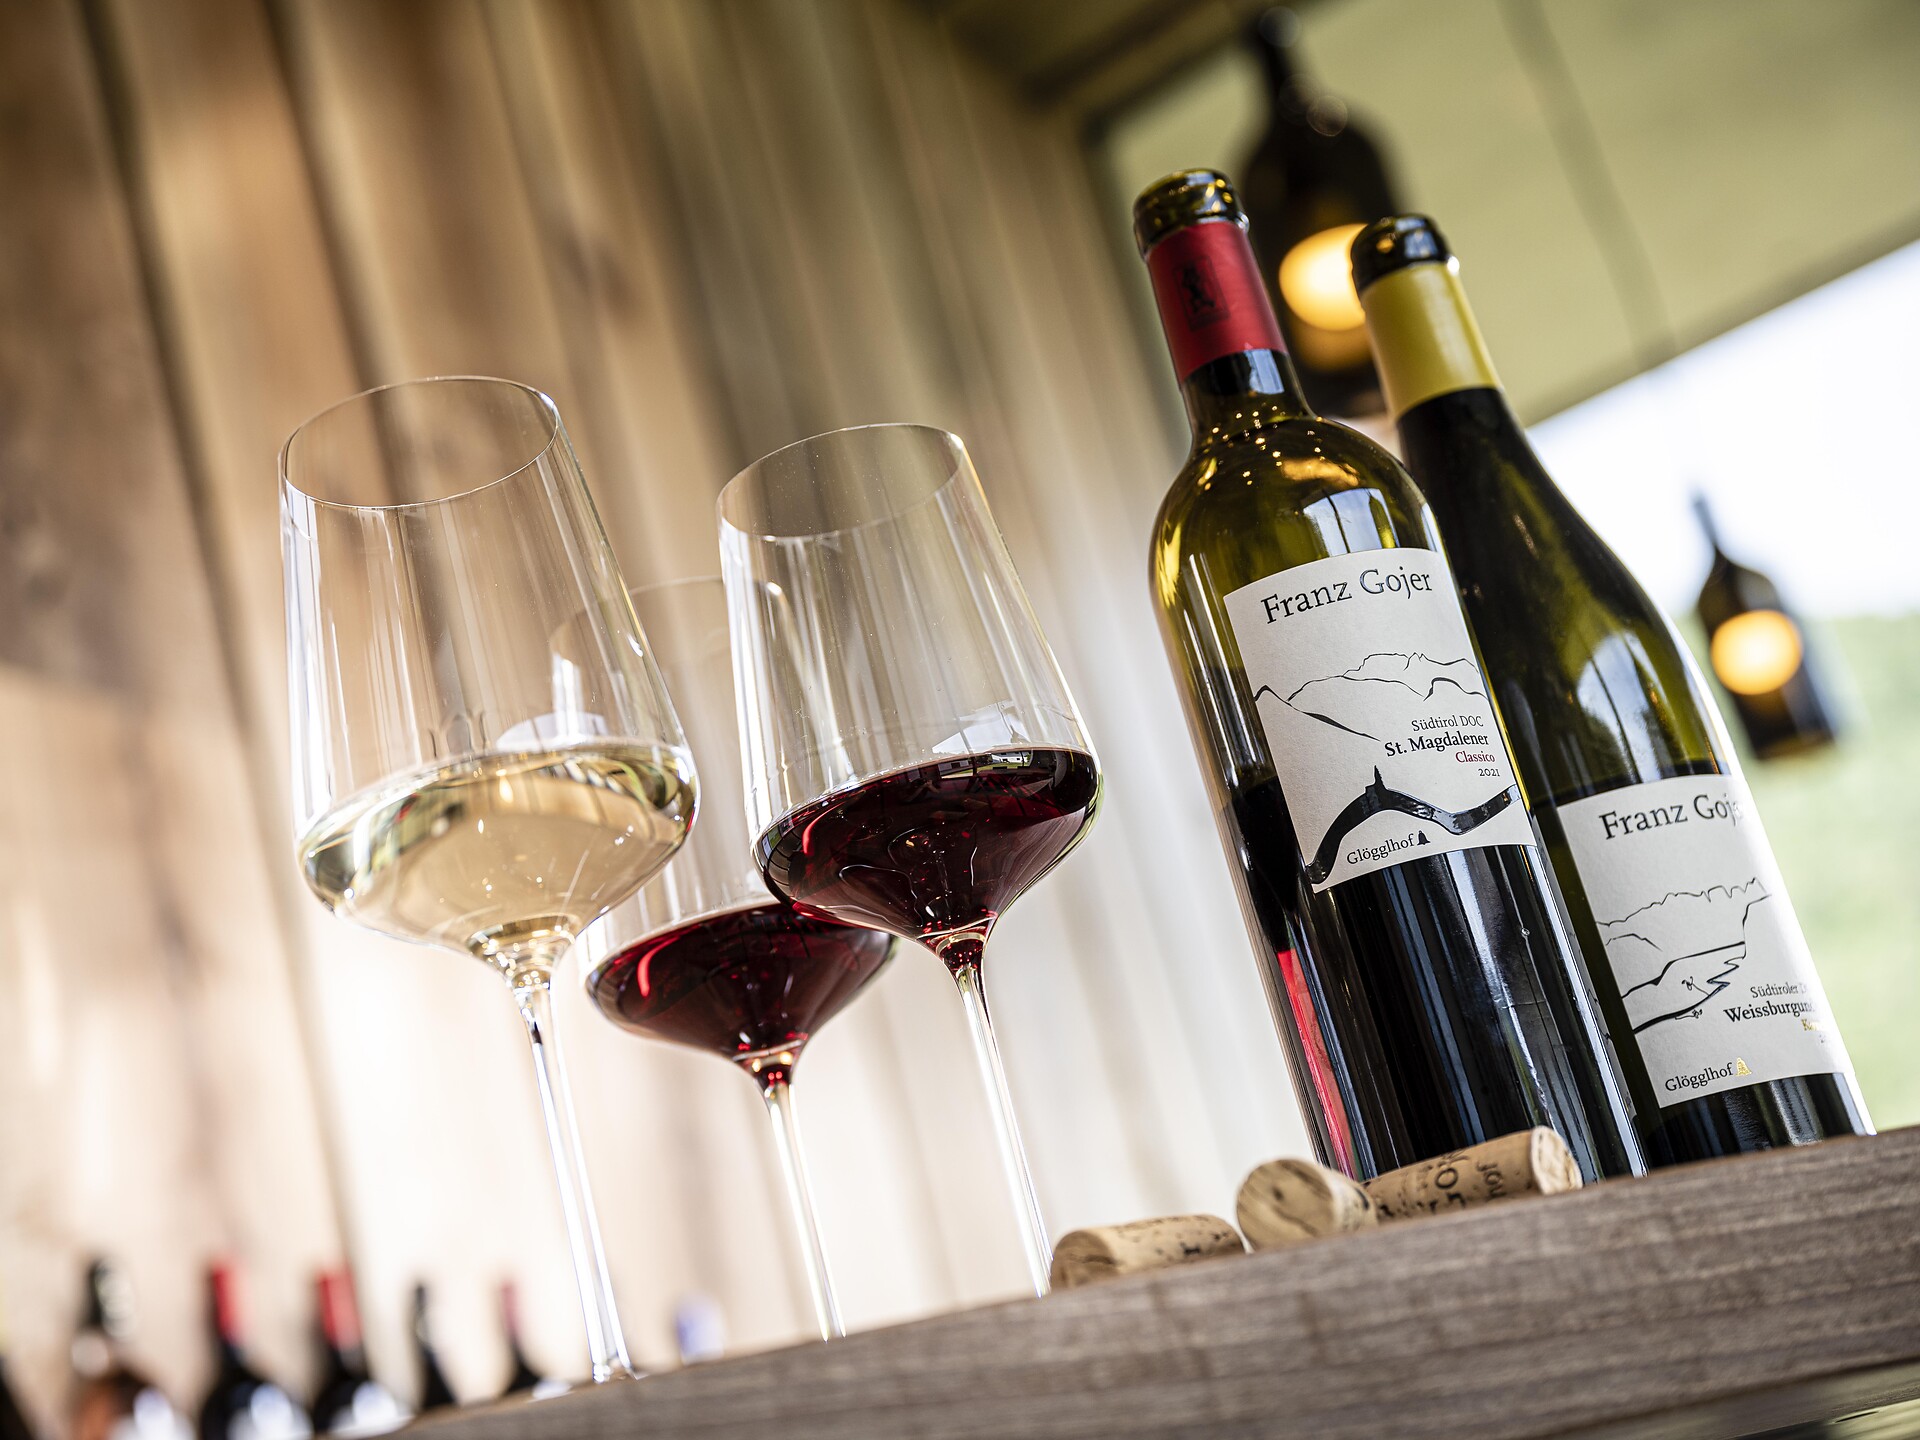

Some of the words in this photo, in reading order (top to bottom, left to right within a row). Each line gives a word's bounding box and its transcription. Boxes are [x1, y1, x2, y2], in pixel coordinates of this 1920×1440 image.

[1261, 582, 1352, 624] Franz
[1359, 566, 1432, 599] Gojer
[1411, 715, 1458, 732] Südtirol
[1459, 715, 1484, 727] DOC
[1384, 742, 1408, 757] St.
[1408, 731, 1489, 752] Magdalener
[1455, 751, 1495, 763] Classico
[1478, 768, 1500, 777] 2021
[1599, 805, 1688, 840] Franz
[1346, 834, 1414, 865] Glögglhof
[1750, 982, 1799, 999] Südtiroler
[1664, 1063, 1733, 1092] Glögglhof
